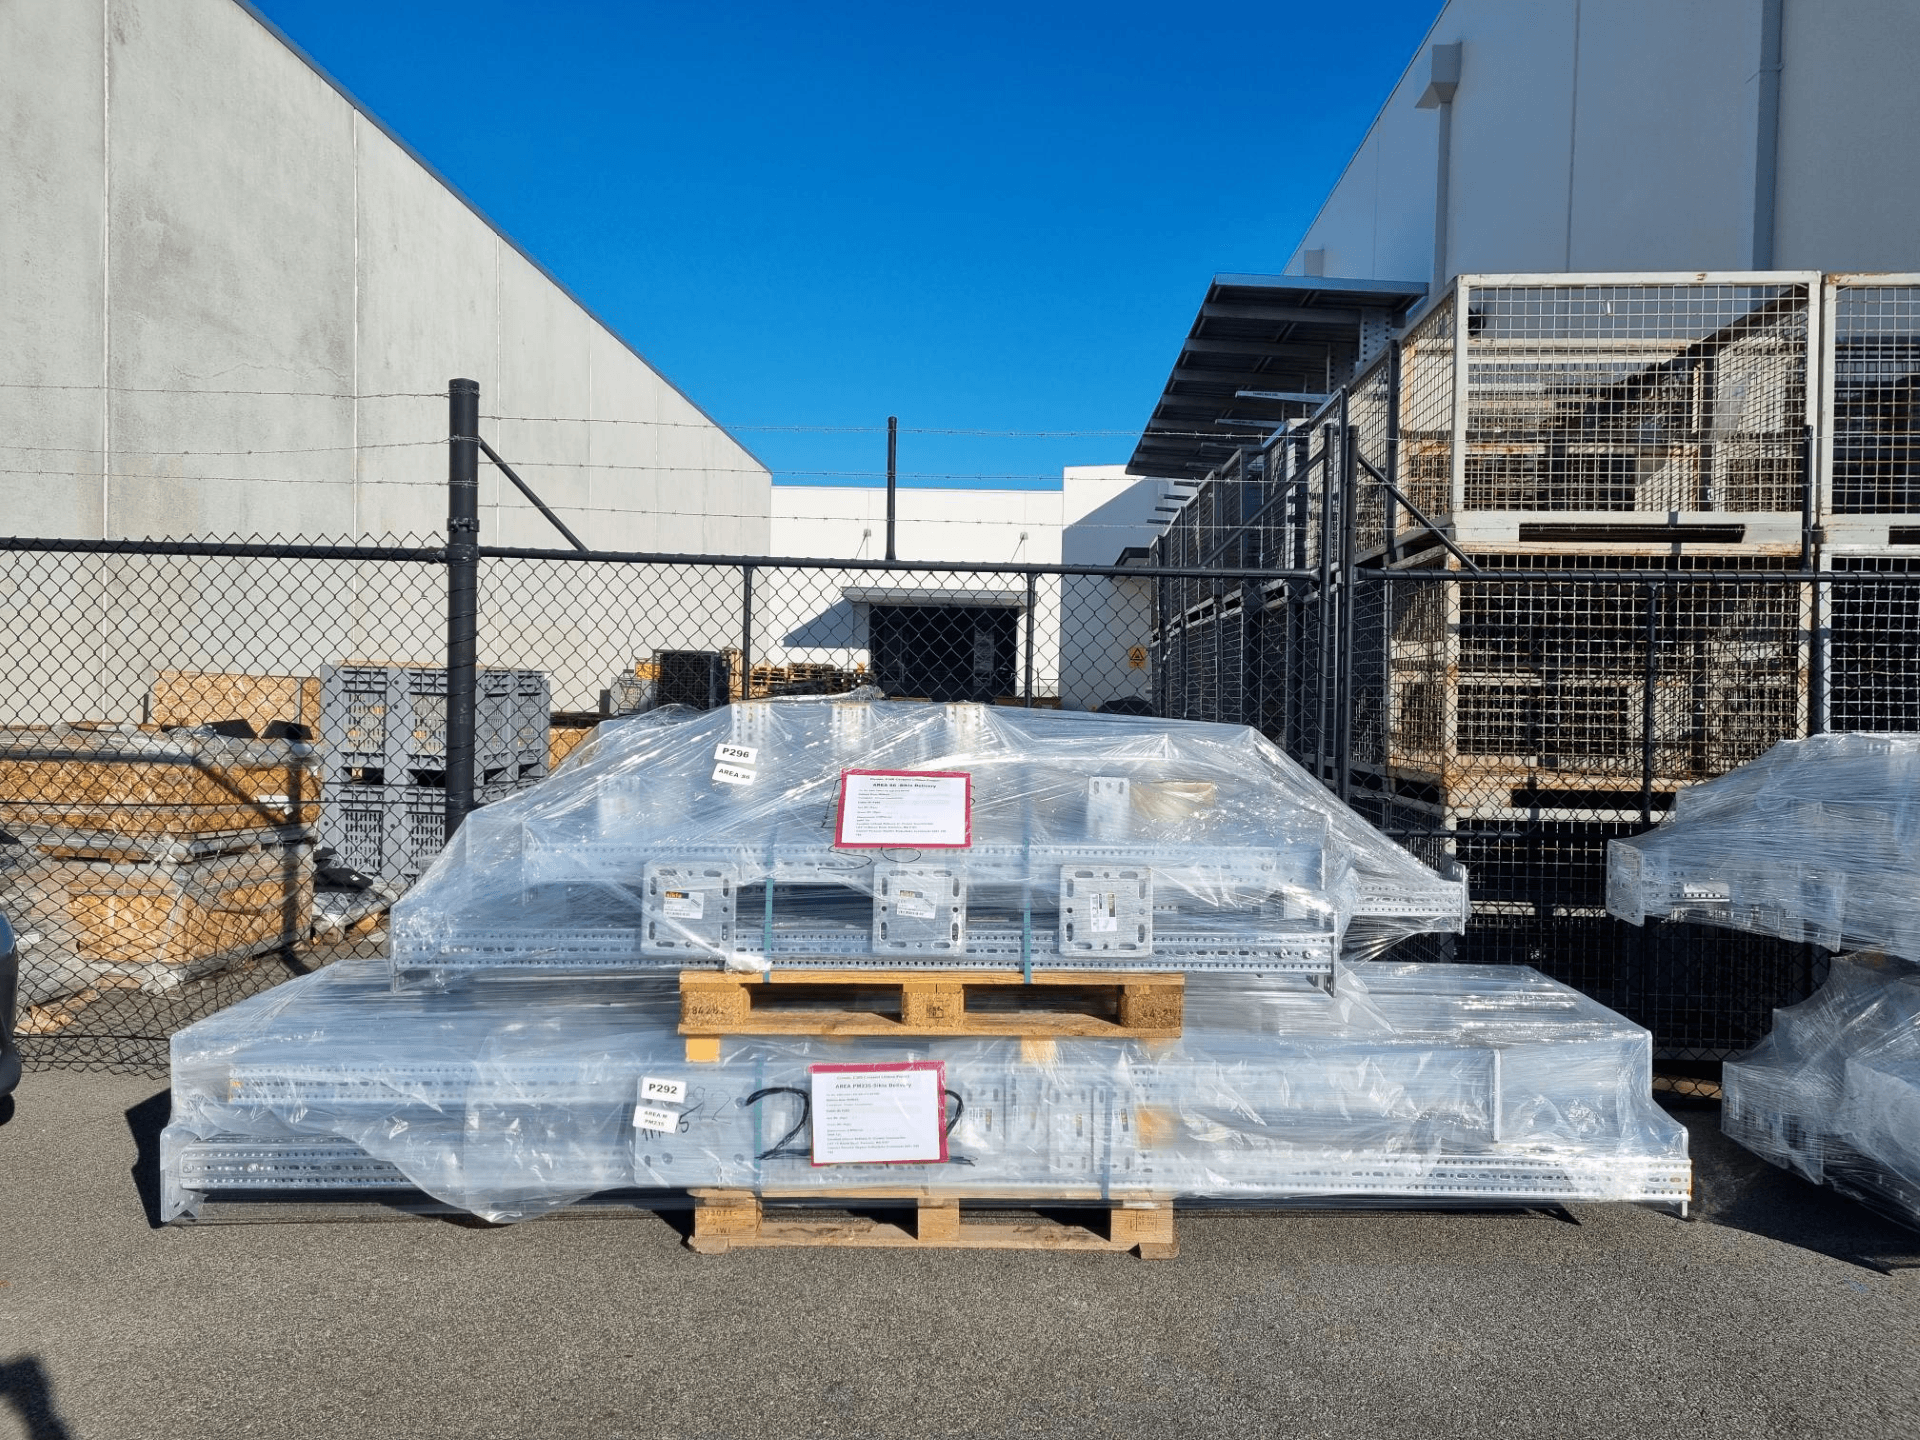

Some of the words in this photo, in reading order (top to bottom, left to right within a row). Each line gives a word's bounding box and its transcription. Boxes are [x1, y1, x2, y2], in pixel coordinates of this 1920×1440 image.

[722, 747, 749, 758] P296
[718, 768, 739, 778] AREA
[648, 1083, 678, 1095] P292
